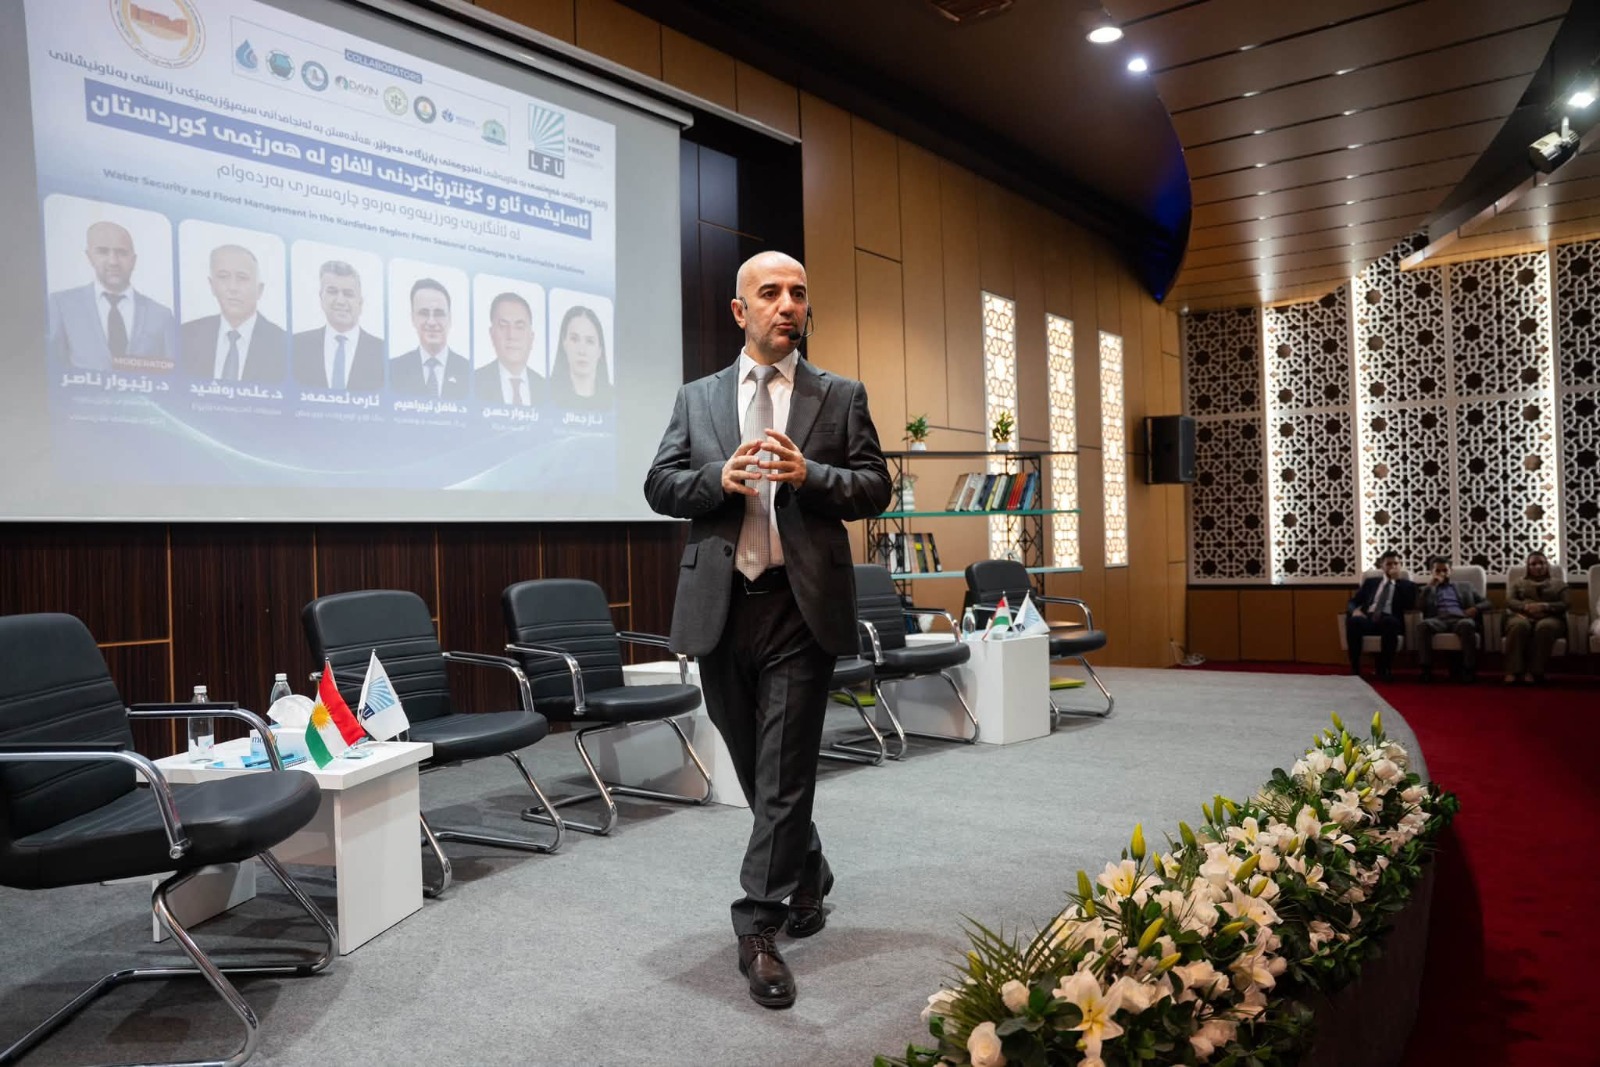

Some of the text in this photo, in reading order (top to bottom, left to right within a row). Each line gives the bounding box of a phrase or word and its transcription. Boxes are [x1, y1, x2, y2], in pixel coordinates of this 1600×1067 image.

[346, 51, 421, 83] COLLABORATORS
[91, 92, 207, 138] کوردستان
[567, 136, 601, 152] LEBANESE
[568, 146, 595, 159] FRENCH
[306, 147, 326, 167] لە
[330, 153, 373, 176] لافاو
[530, 152, 563, 176] LFU
[486, 194, 496, 211] و
[499, 194, 520, 214] ئاو
[102, 168, 139, 184] Water
[142, 176, 188, 196] Security
[190, 188, 211, 200] and
[213, 191, 242, 206] Flood
[244, 197, 307, 219] Management
[309, 209, 318, 220] in
[320, 212, 335, 224] the
[337, 215, 378, 233] Kurdistan
[412, 232, 432, 244] From
[433, 236, 466, 251] Seasonal
[468, 244, 507, 260] Challenges
[517, 253, 556, 269] Sustainable
[556, 261, 585, 275] Solutions
[114, 357, 175, 369] MODERATOR
